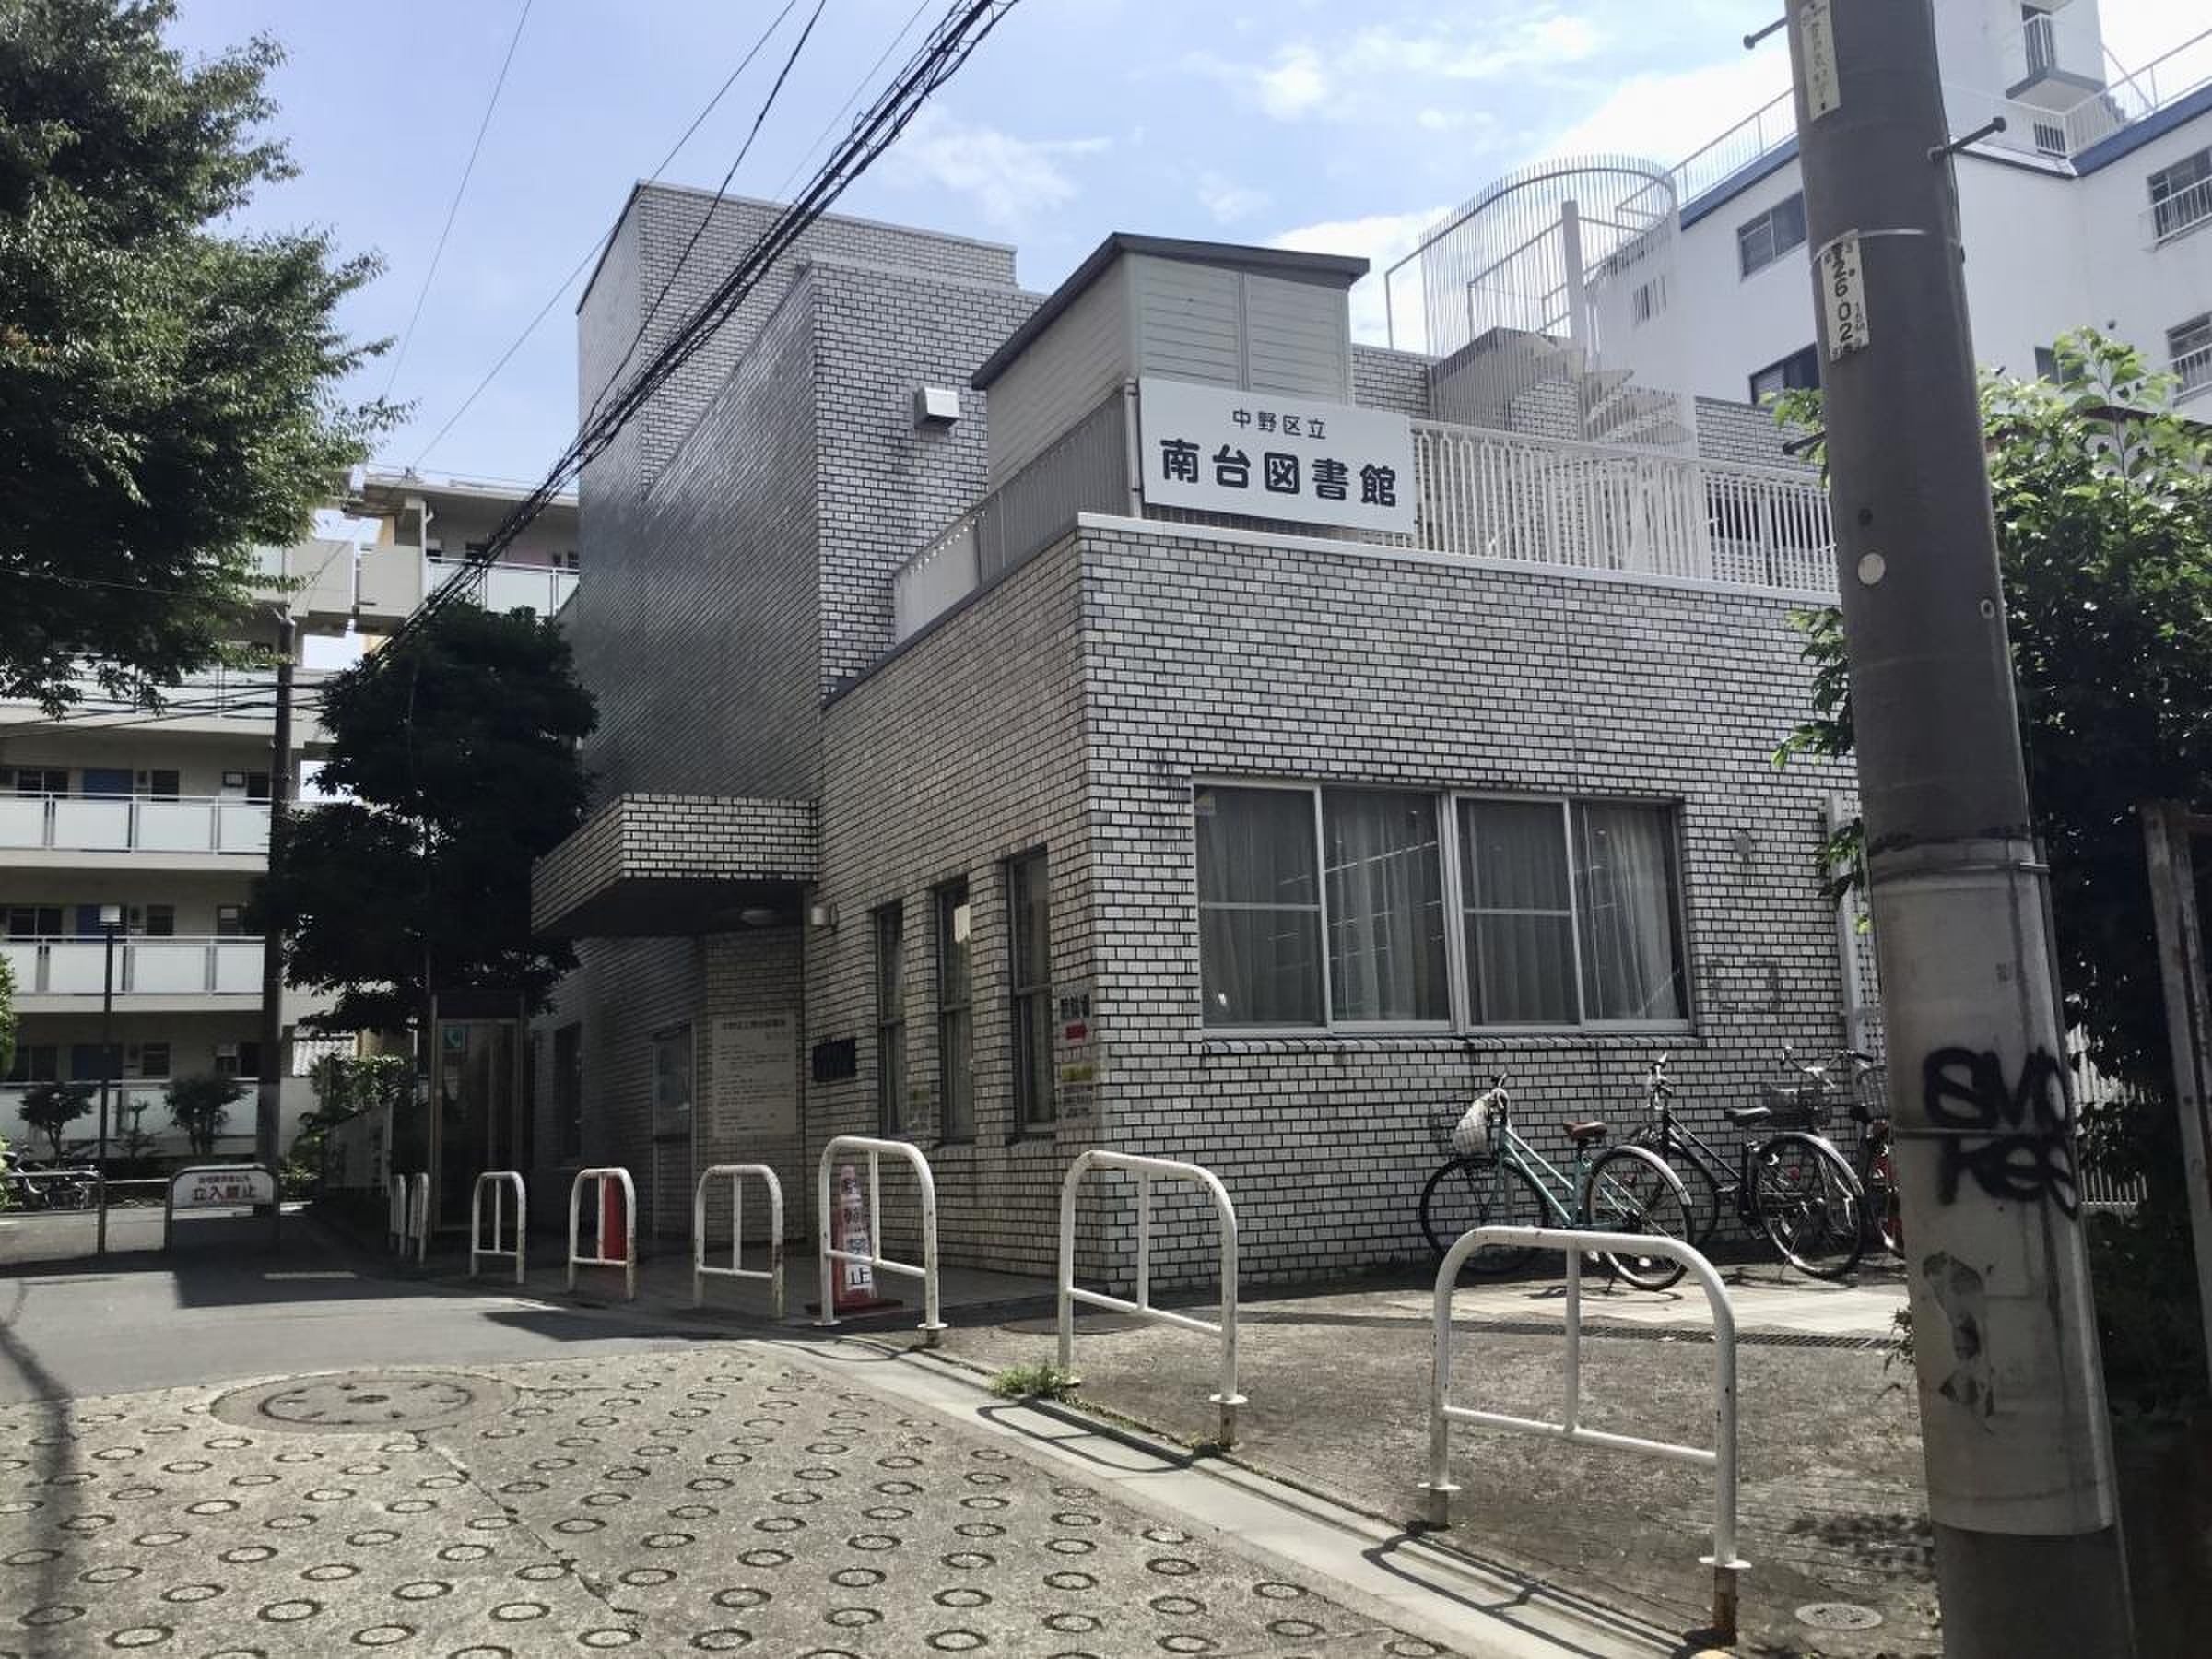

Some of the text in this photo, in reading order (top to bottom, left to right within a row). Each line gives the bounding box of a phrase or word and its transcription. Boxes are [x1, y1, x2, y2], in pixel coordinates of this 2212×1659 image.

[1233, 408, 1326, 440] 中野区立
[1159, 438, 1397, 507] 南台図書館
